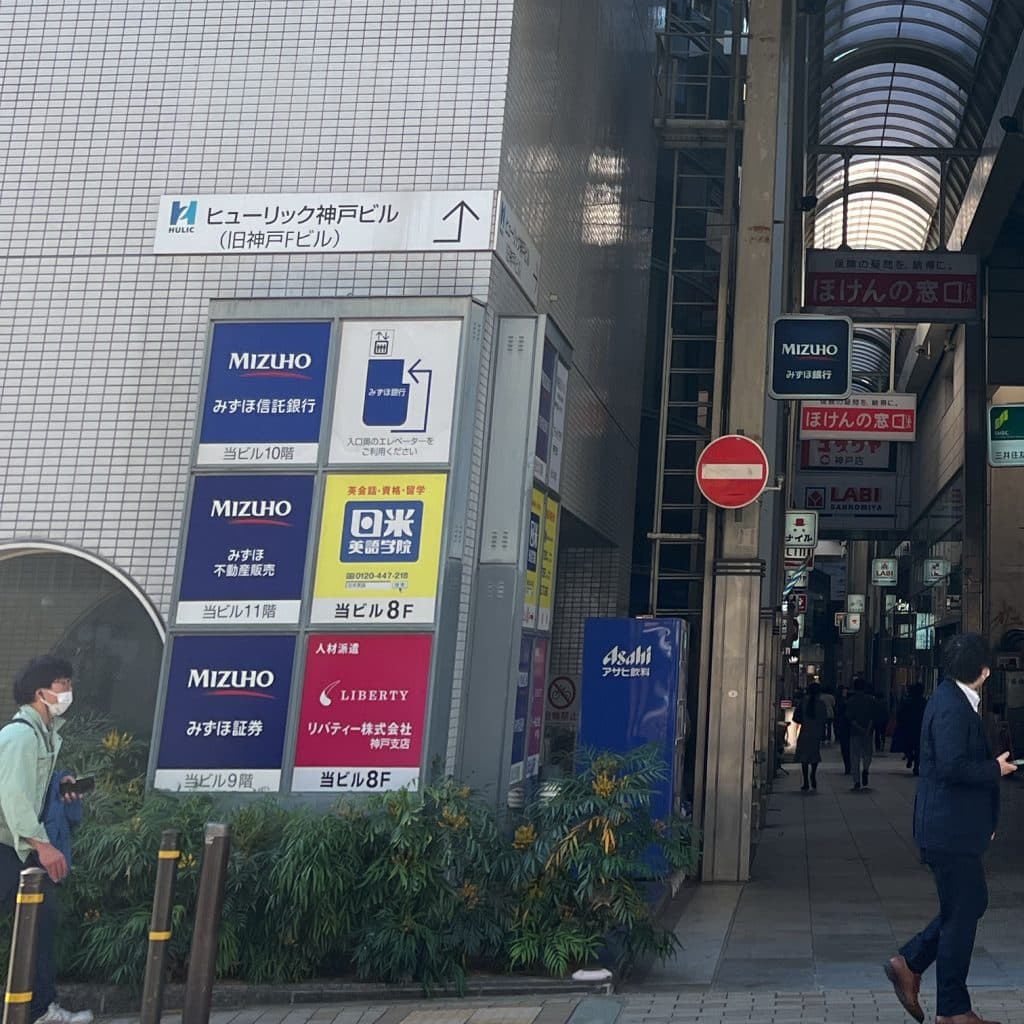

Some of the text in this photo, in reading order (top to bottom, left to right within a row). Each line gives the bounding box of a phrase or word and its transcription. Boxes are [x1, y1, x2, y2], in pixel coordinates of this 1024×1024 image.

[207, 204, 400, 226] ヒューリック神戸ビル
[168, 226, 195, 234] HULIC
[813, 279, 963, 304] ほけんの窓口
[781, 343, 838, 356] MIZUHO
[228, 352, 312, 370] MIZUHO
[785, 370, 832, 380] みずほ銀行
[368, 388, 407, 398] みずほ銀行
[212, 398, 316, 414] みずほ信託銀行
[805, 411, 905, 429] ほけんの窓口
[223, 446, 295, 461] 当ビル10階
[831, 487, 881, 502] LABI
[210, 500, 292, 517] MIZUHO
[350, 508, 416, 538] 日米
[227, 548, 264, 561] みずほ
[348, 539, 411, 555] 英語学院
[214, 564, 275, 578] 不動産販売
[202, 604, 277, 619] 当ビル11階
[334, 600, 414, 619] 当ビル8F
[315, 642, 359, 655] 人材派遣
[602, 645, 652, 666] Asahi
[187, 668, 275, 688] MIZUHO
[602, 667, 650, 677] アサヒ飲料
[341, 690, 409, 701] LIBERTY
[186, 720, 263, 737] みずほ証券
[307, 722, 412, 736] リバティー株式会社
[370, 738, 410, 750] 神戸支店
[184, 773, 253, 789] 当ビル9階
[320, 770, 391, 789] 当ビル8F
